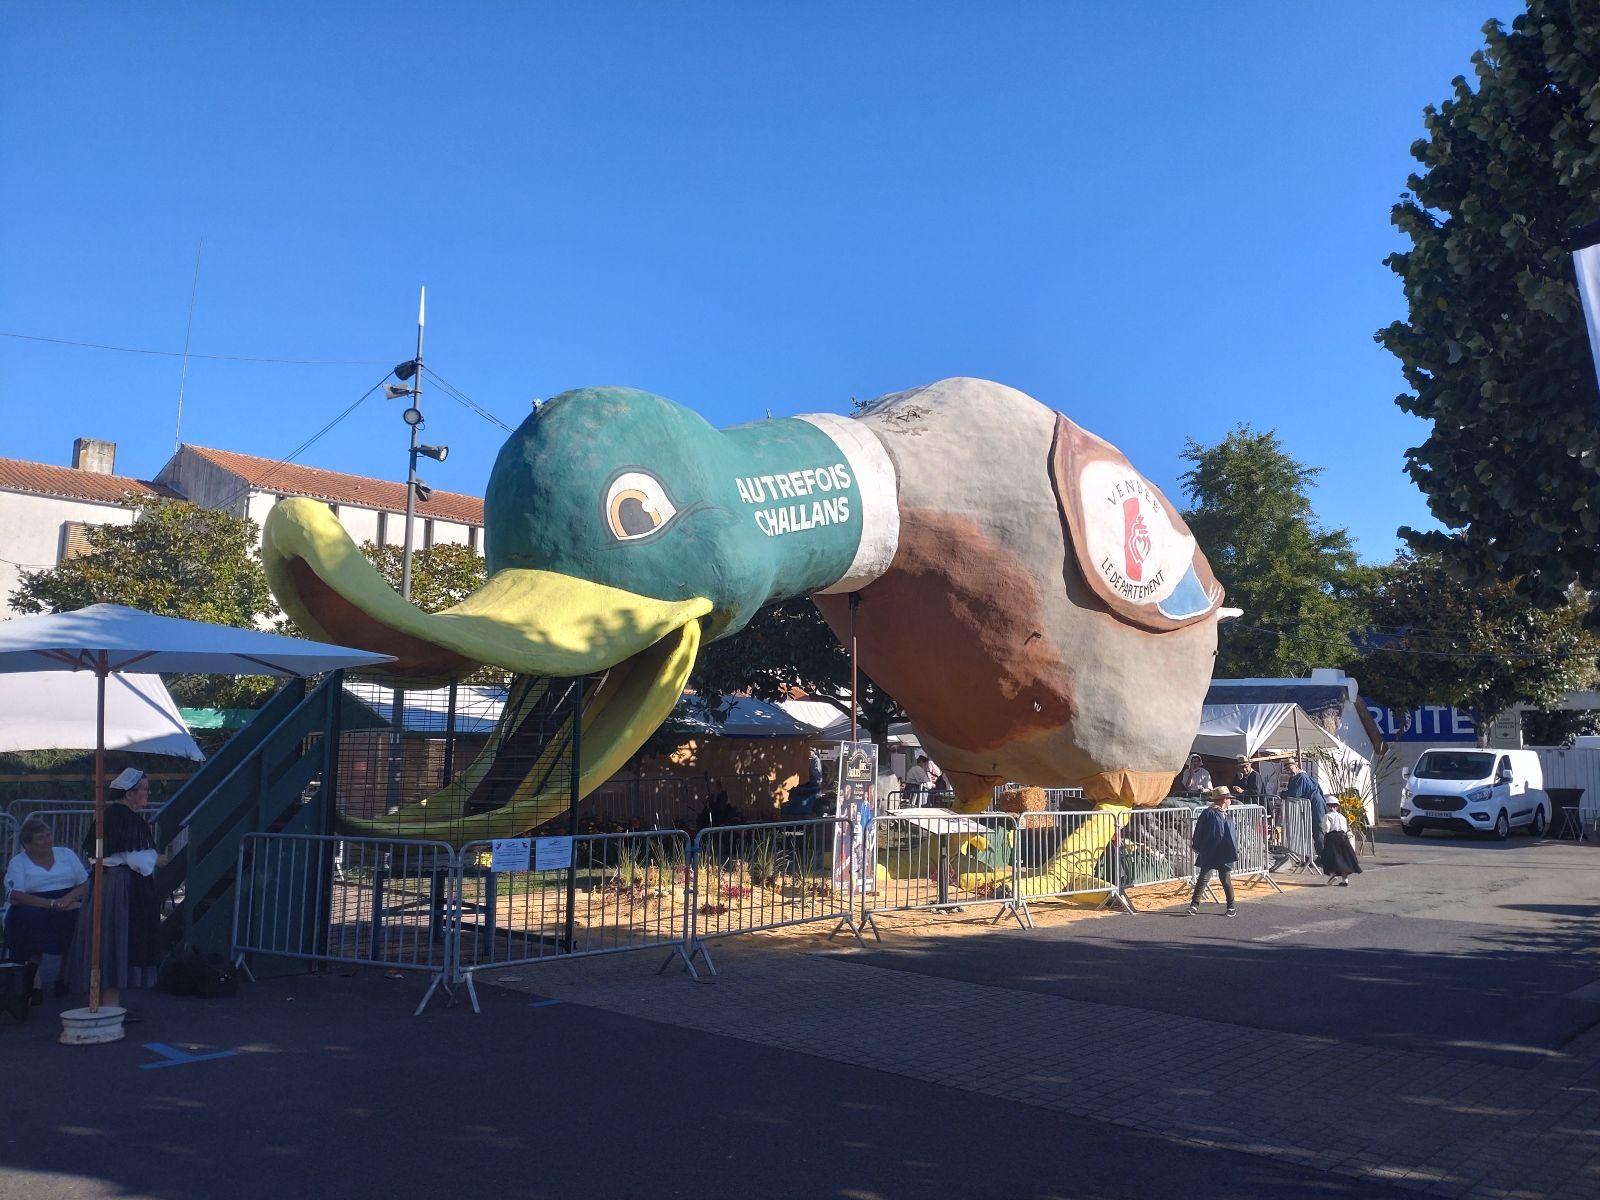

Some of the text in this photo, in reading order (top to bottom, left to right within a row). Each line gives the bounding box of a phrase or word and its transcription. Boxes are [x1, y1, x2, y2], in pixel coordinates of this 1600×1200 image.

[735, 463, 852, 504] AUTREFOIS
[754, 496, 850, 537] CHALLANS
[1101, 557, 1164, 599] LE DEPARTEMENT
